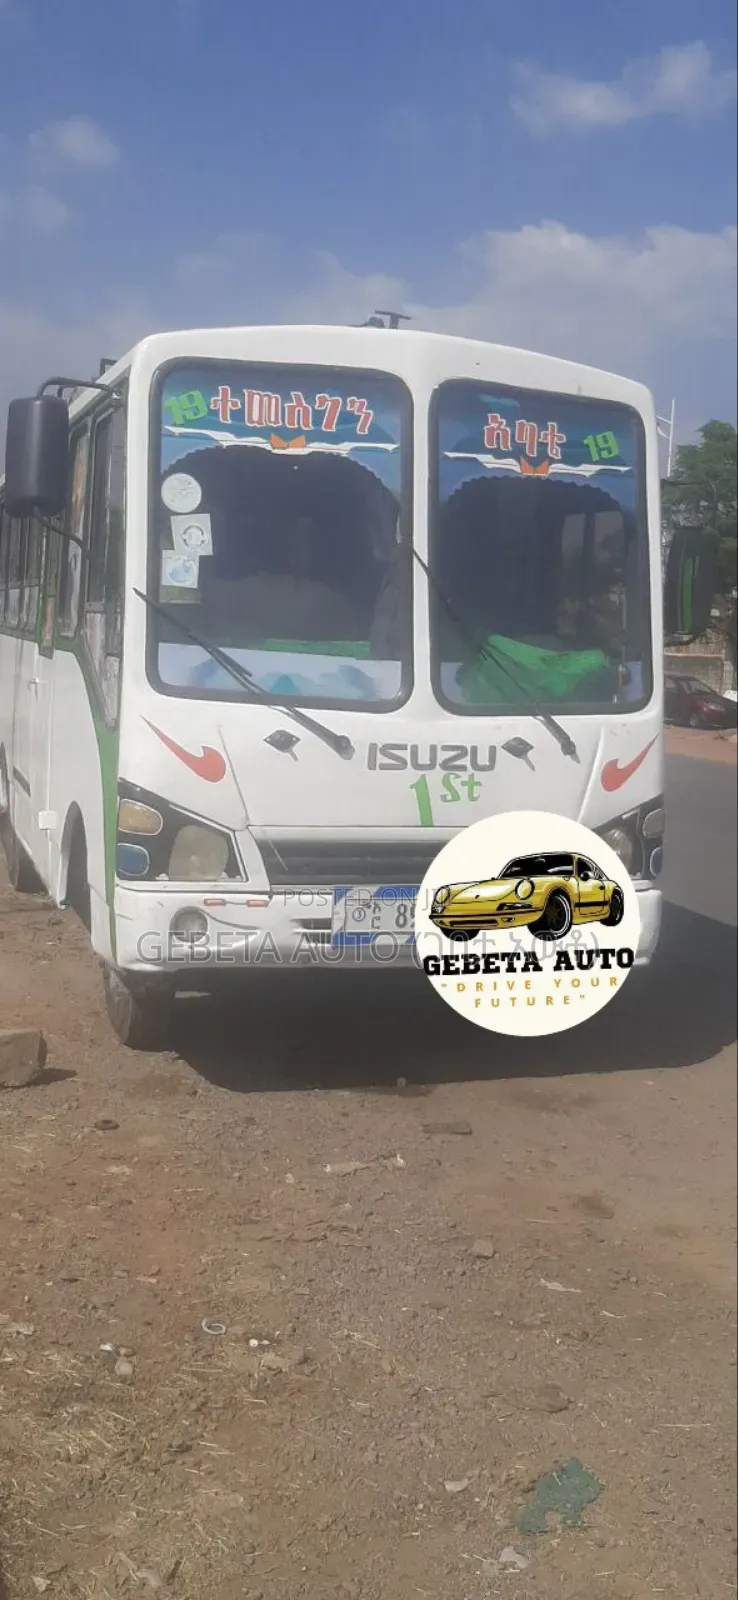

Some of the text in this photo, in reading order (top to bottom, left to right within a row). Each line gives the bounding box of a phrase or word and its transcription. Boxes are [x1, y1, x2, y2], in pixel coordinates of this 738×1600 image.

[165, 390, 209, 425] 19
[584, 431, 619, 462] 19
[367, 742, 497, 772] ISUZU
